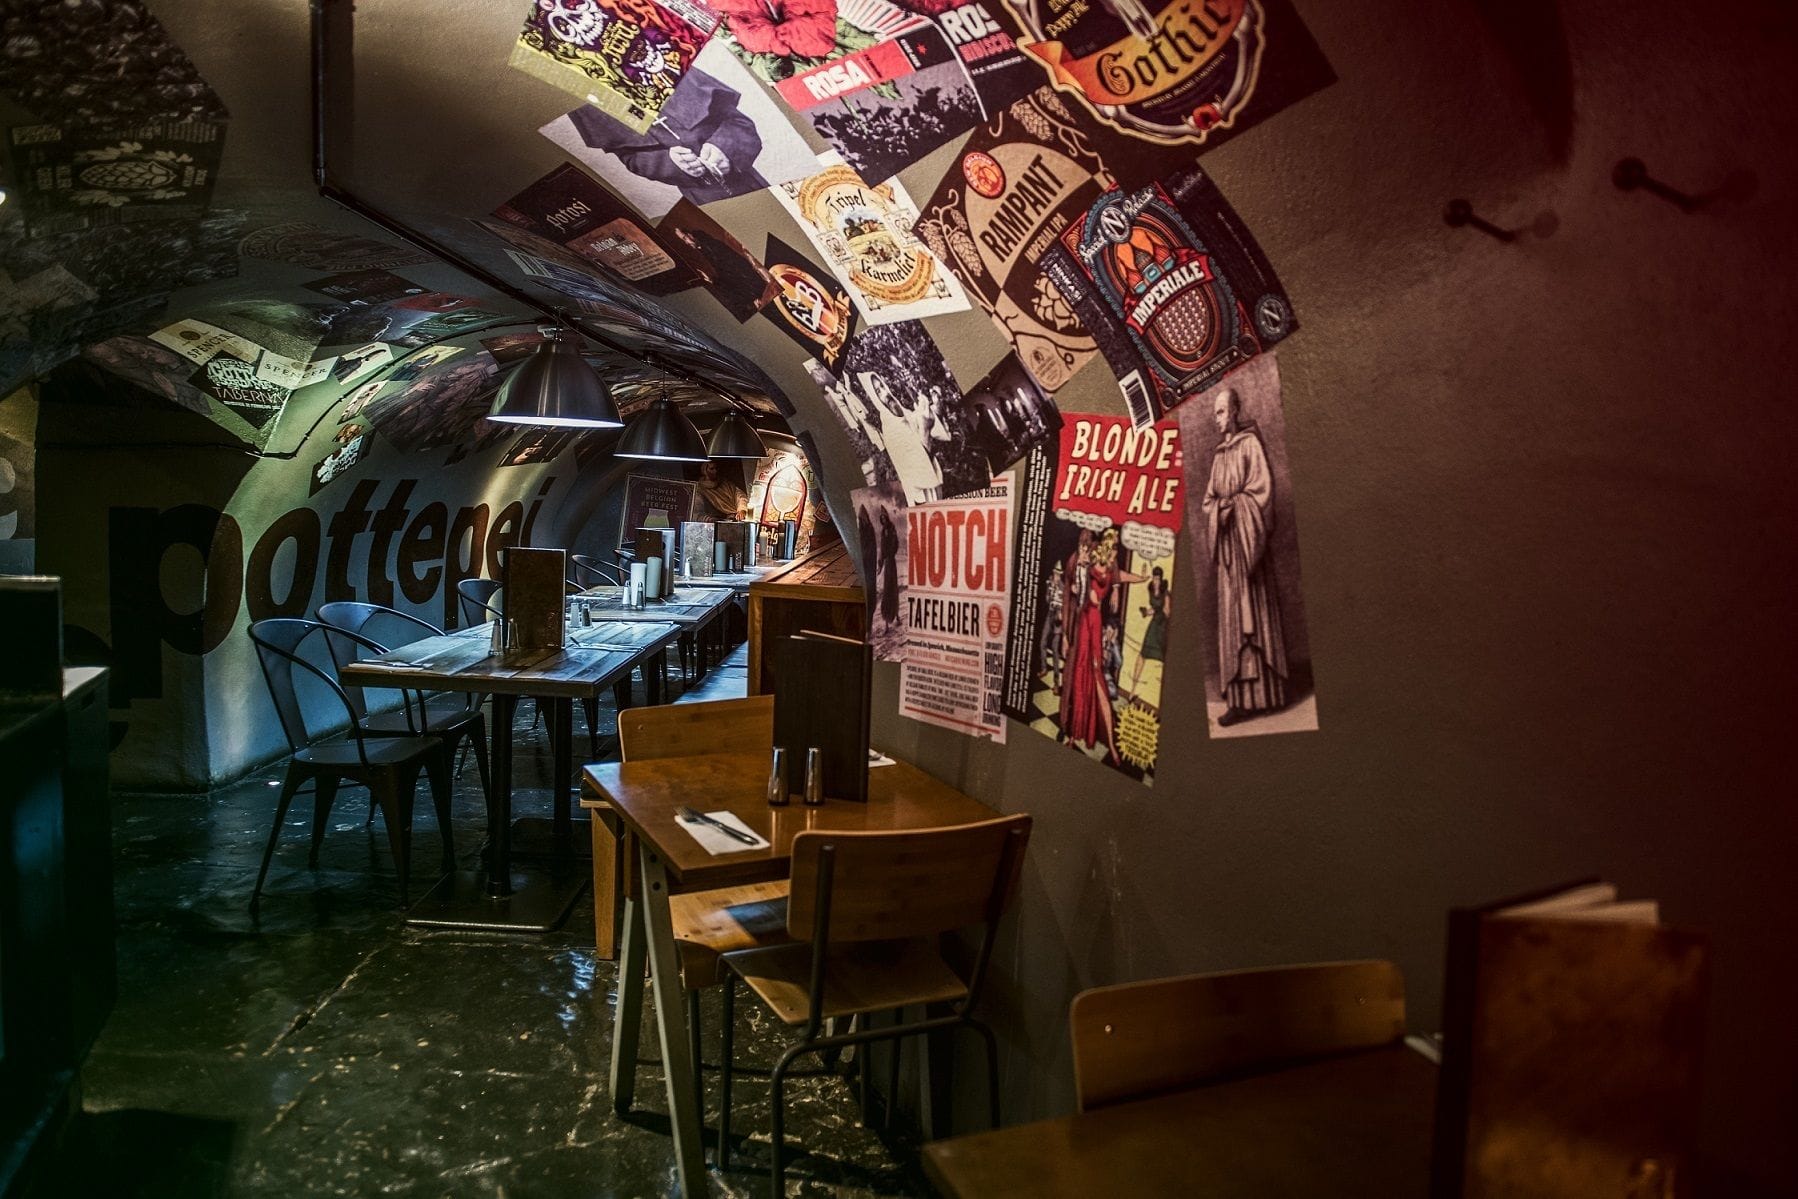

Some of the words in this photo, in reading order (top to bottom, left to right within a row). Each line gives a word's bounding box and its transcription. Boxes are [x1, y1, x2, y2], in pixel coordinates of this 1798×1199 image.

[939, 3, 1001, 45] ROS
[1096, 0, 1233, 95] Gothic
[802, 60, 871, 101] ROSA
[825, 188, 867, 213] Tripel
[979, 153, 1065, 263] RAMPANT
[1024, 222, 1056, 265] IMPERIAL
[1050, 212, 1068, 235] IPA
[1050, 261, 1084, 301] NINKASI
[1132, 260, 1205, 326] IMPERIALE
[186, 331, 236, 359] SPENCER
[264, 362, 328, 378] SPENCER
[984, 485, 1008, 498] BEER
[1059, 464, 1127, 501] IRISH
[1127, 474, 1180, 514] ALE
[908, 508, 1008, 593] NOTCH
[907, 597, 980, 638] TAFELBIER
